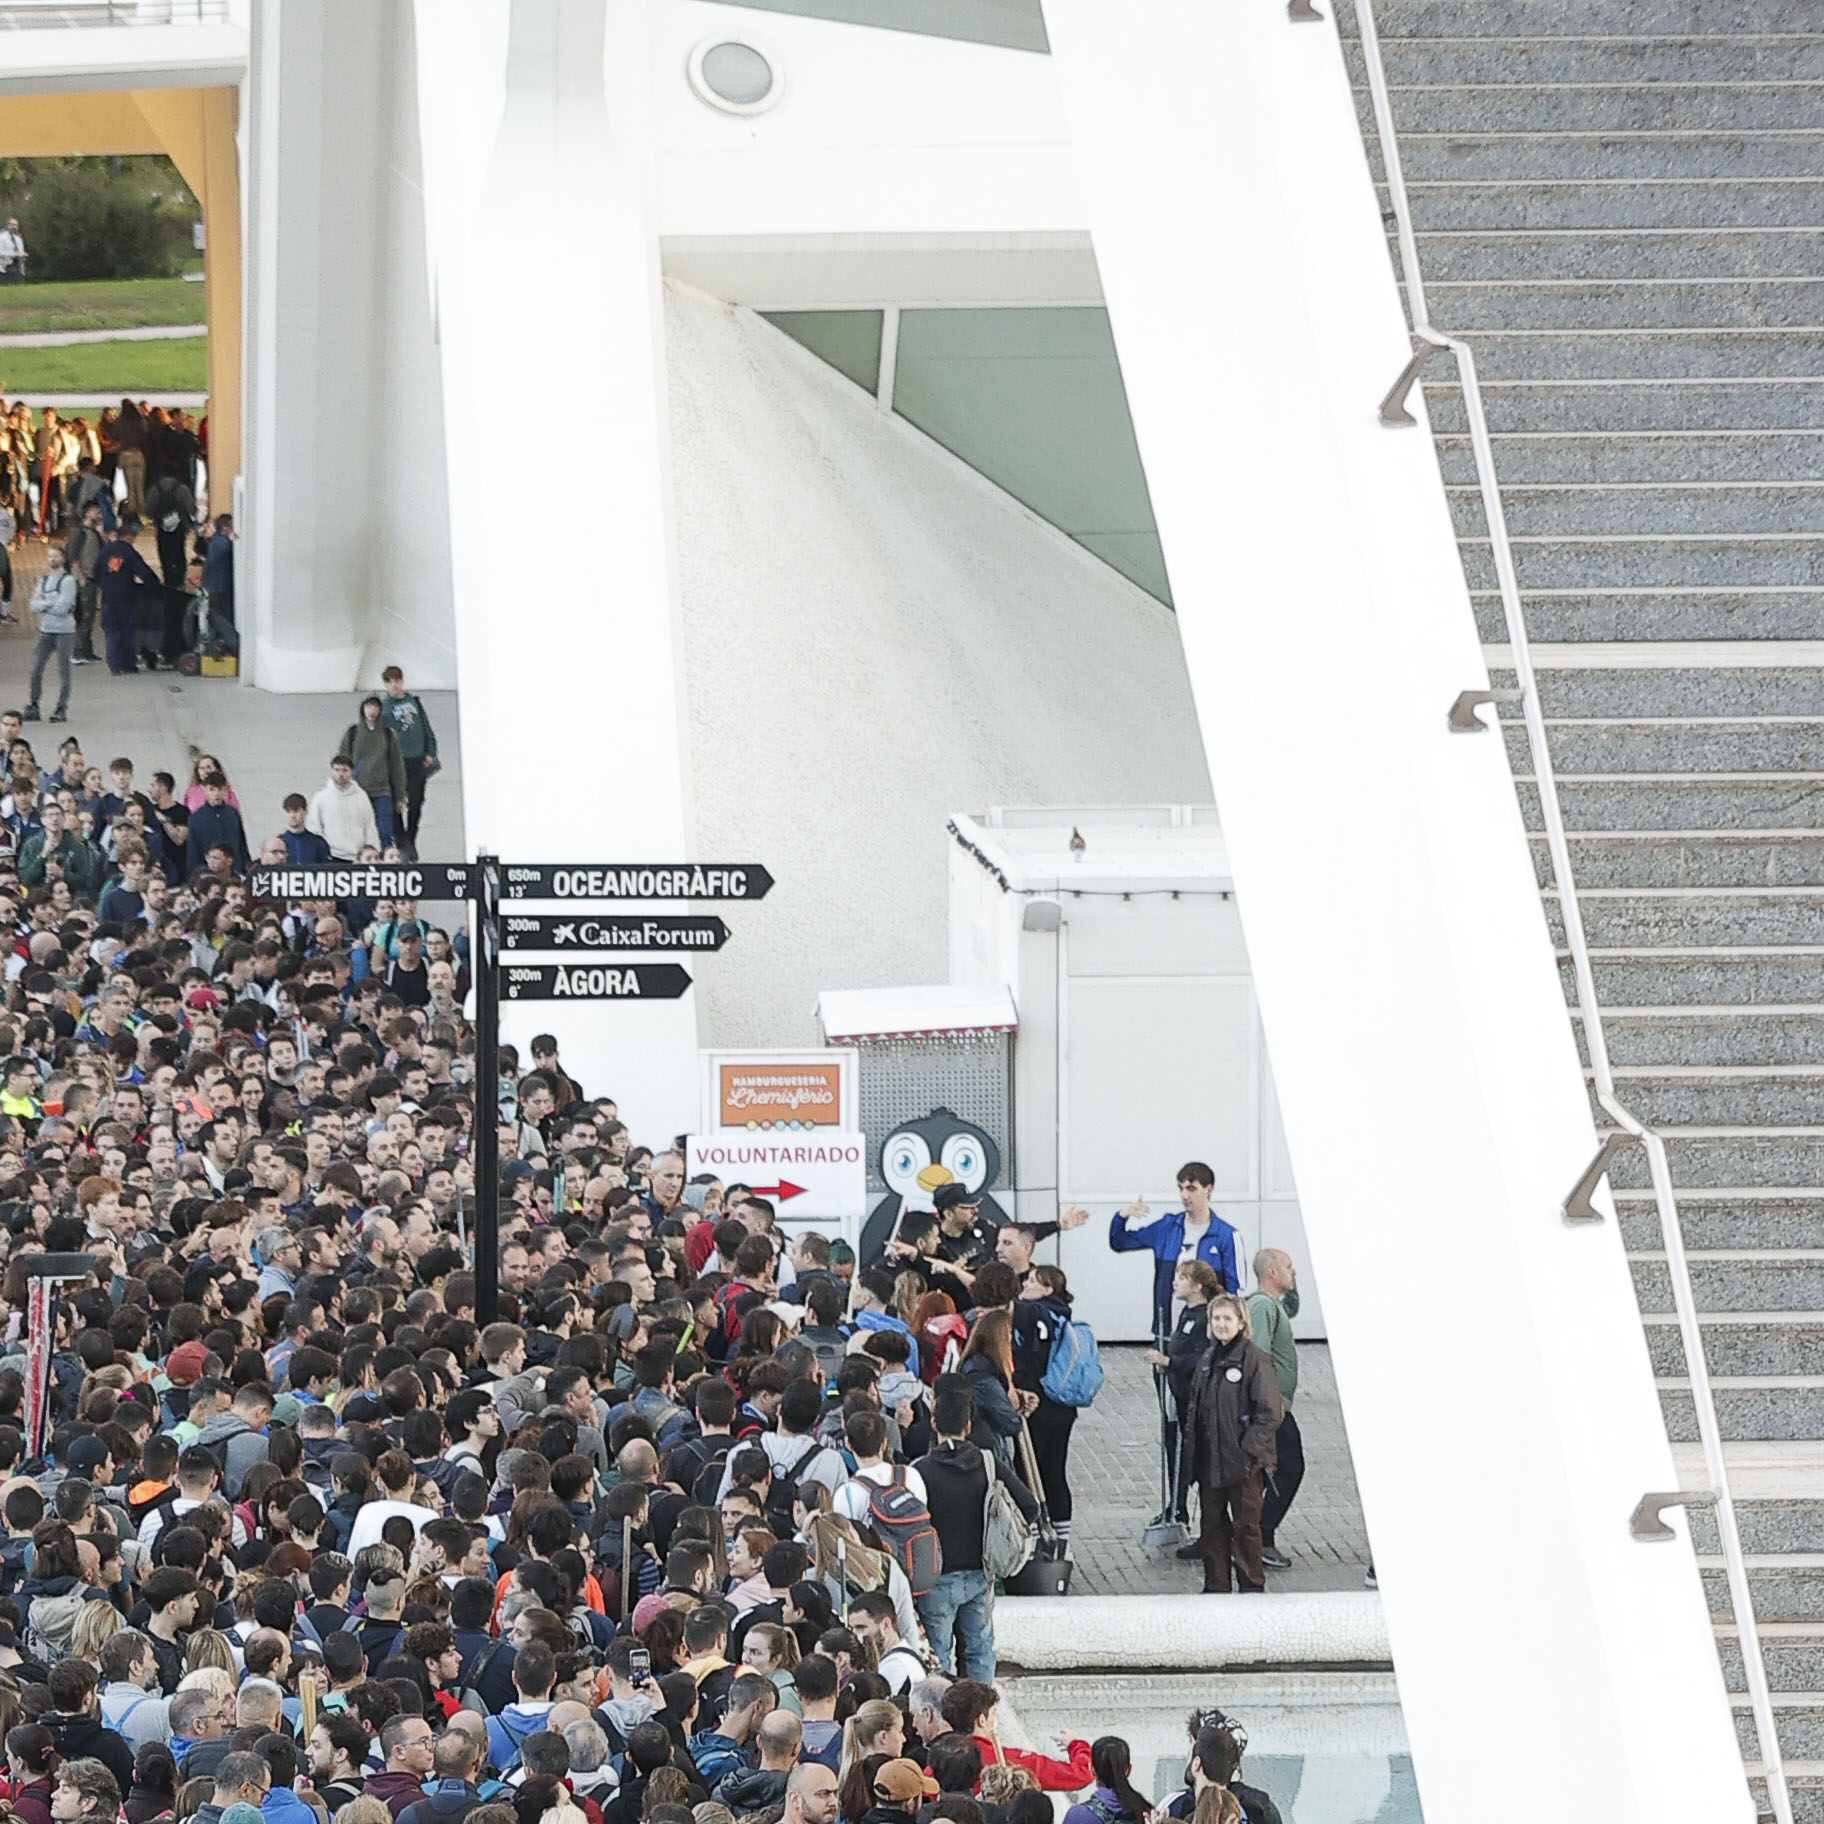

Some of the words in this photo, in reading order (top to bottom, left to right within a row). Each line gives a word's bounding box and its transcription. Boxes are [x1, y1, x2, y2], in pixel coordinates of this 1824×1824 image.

[271, 866, 423, 898] HEMISFÈRIC
[507, 868, 541, 882] 650m
[552, 866, 747, 897] OCEANOGRÀFIC
[507, 919, 540, 932] 300m
[579, 921, 715, 946] CaixaForum
[508, 968, 542, 982] 300m
[553, 965, 641, 996] ÀGORA
[696, 1146, 860, 1164] VOLUNTARIADO
